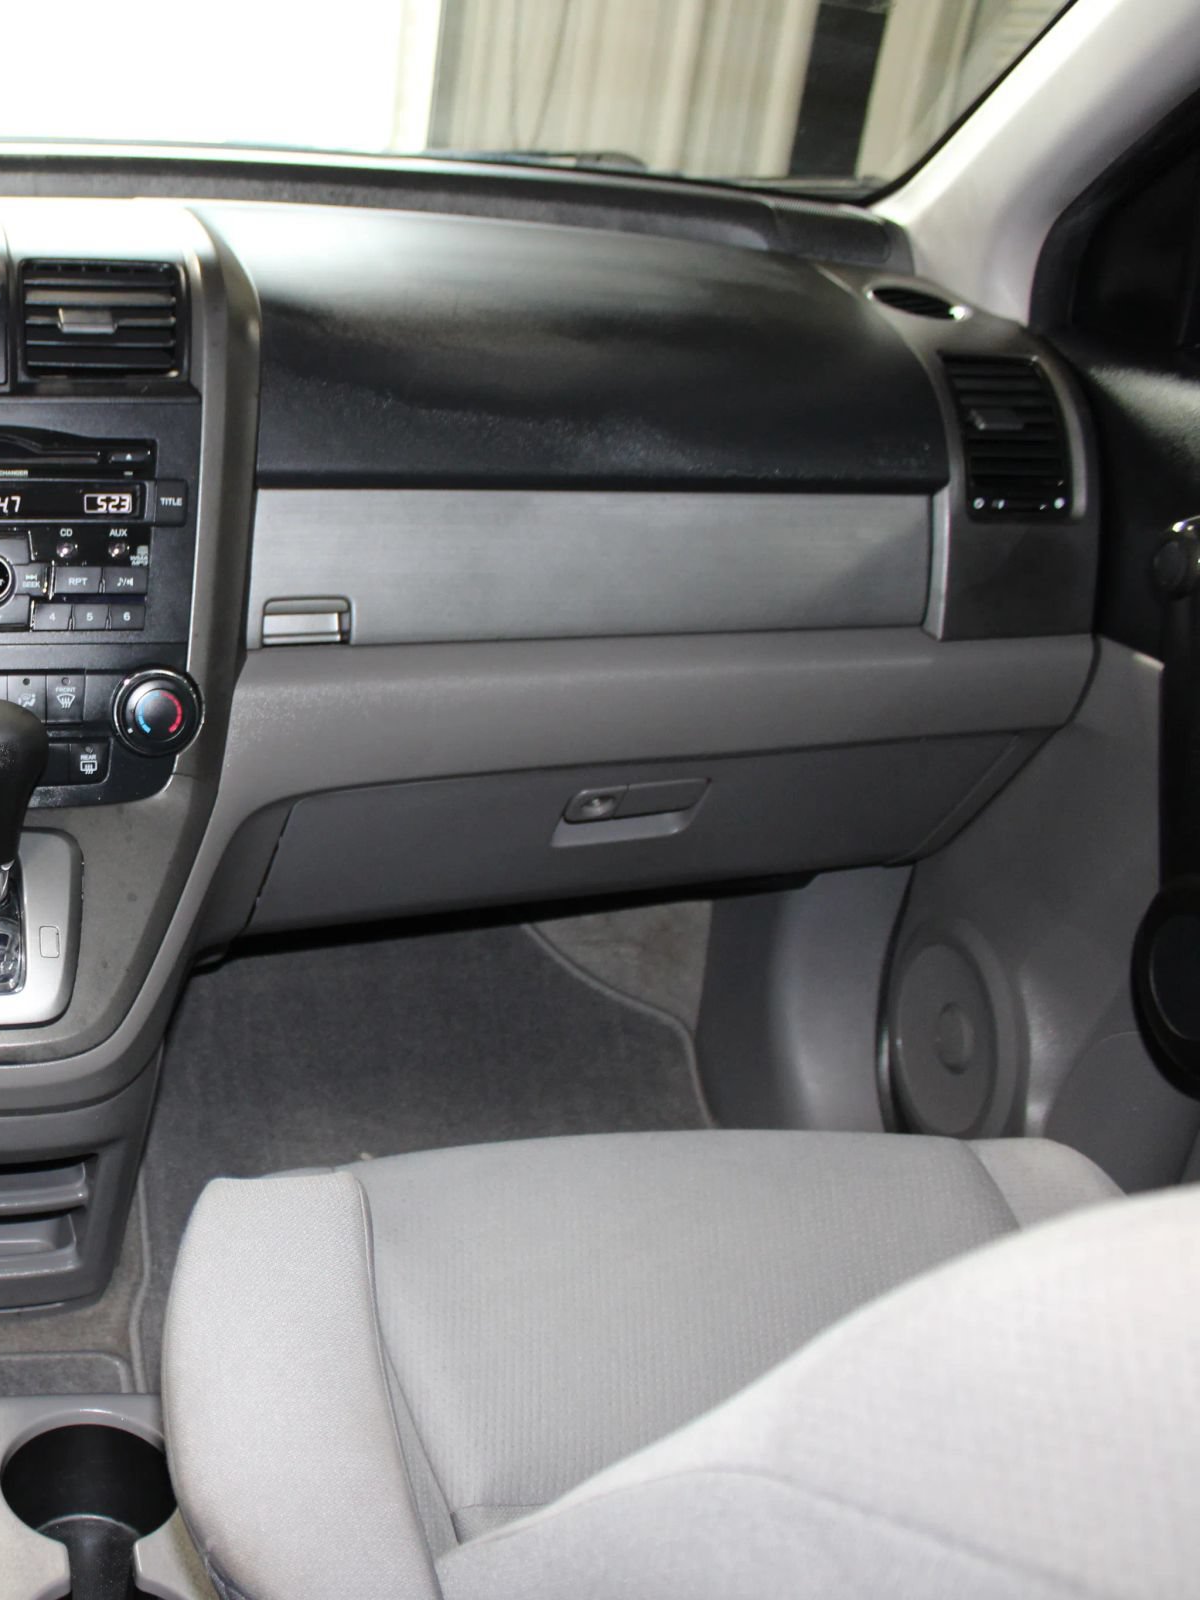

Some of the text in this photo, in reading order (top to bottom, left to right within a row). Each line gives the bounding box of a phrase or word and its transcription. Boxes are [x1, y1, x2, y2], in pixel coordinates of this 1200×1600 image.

[159, 497, 183, 507] TITLE
[60, 528, 73, 538] CD
[108, 528, 128, 537] AUX
[67, 577, 88, 587] RPT
[48, 612, 57, 622] 4
[85, 612, 95, 622] 5
[122, 612, 132, 622] 6
